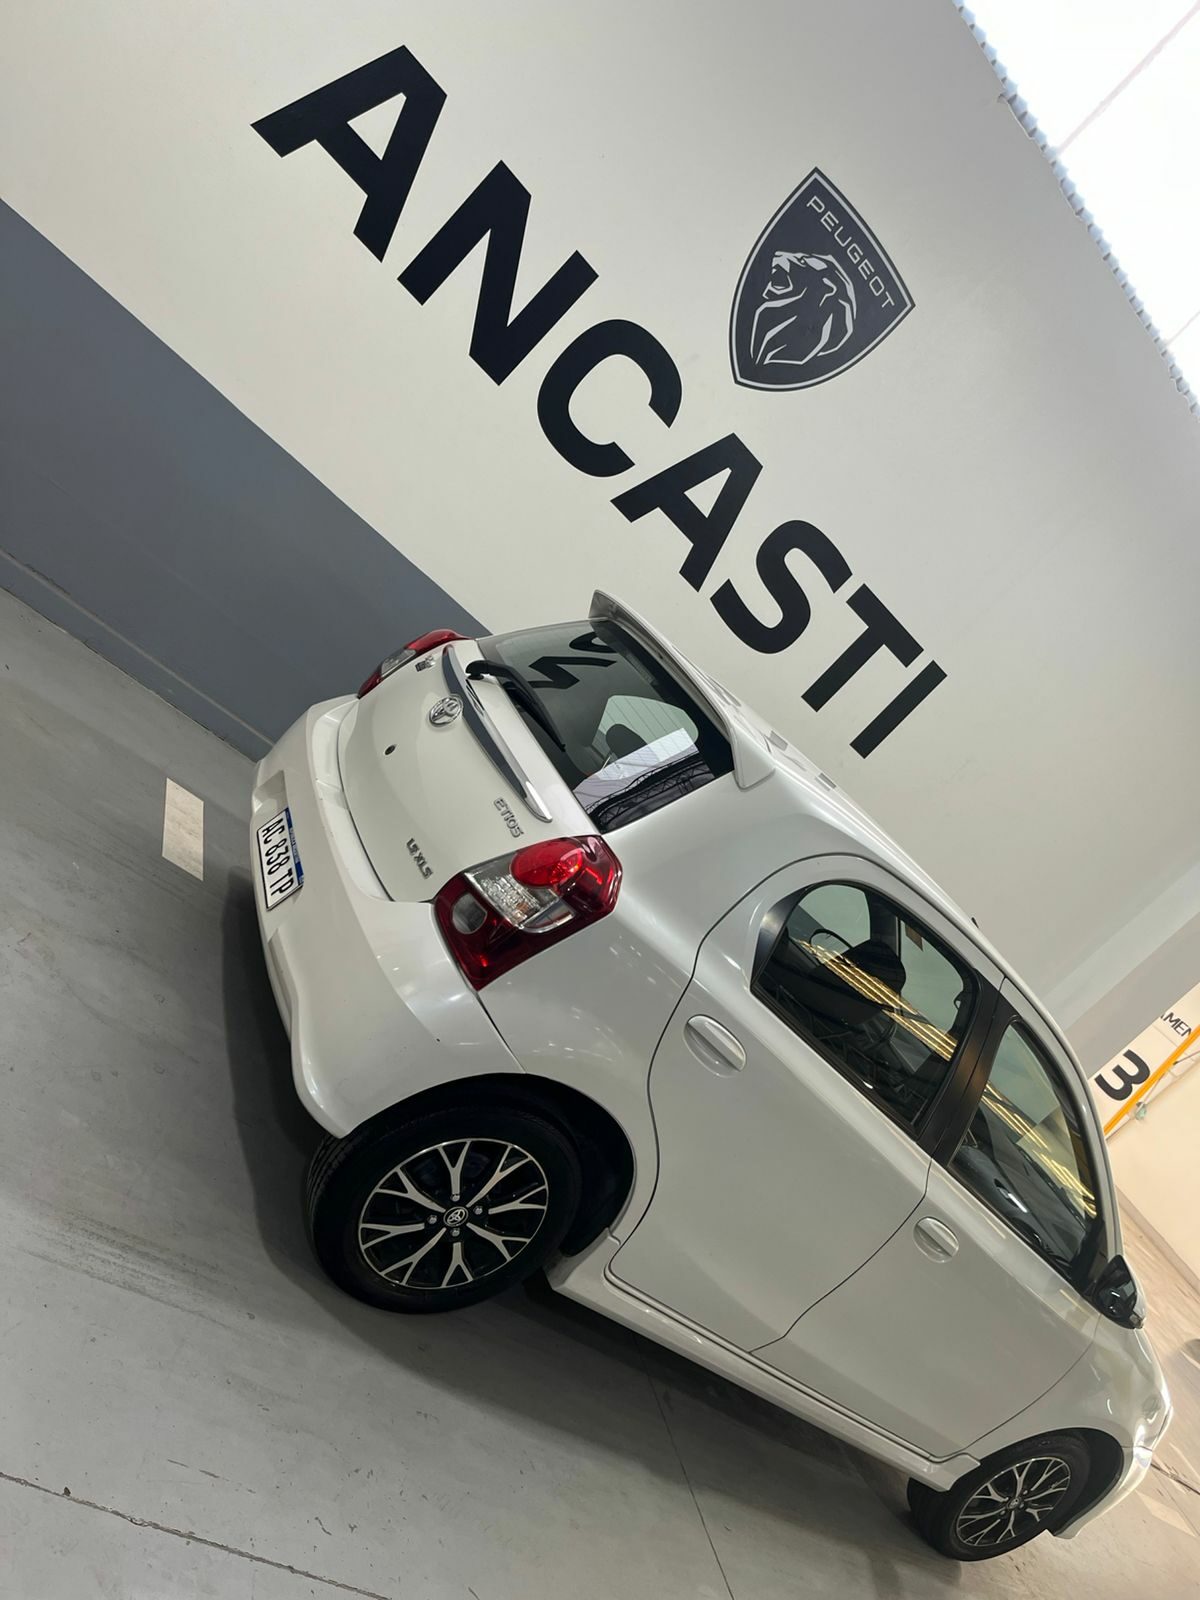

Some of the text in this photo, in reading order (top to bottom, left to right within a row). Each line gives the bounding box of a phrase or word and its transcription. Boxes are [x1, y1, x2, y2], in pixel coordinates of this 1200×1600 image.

[806, 195, 895, 308] PEUGEOT
[250, 44, 947, 760] ANCASTI
[493, 798, 524, 838] ETIOS
[261, 818, 294, 896] AC 838 TP
[414, 852, 433, 880] XLS
[1160, 1011, 1192, 1037] MEN
[1093, 1049, 1151, 1101] 3
